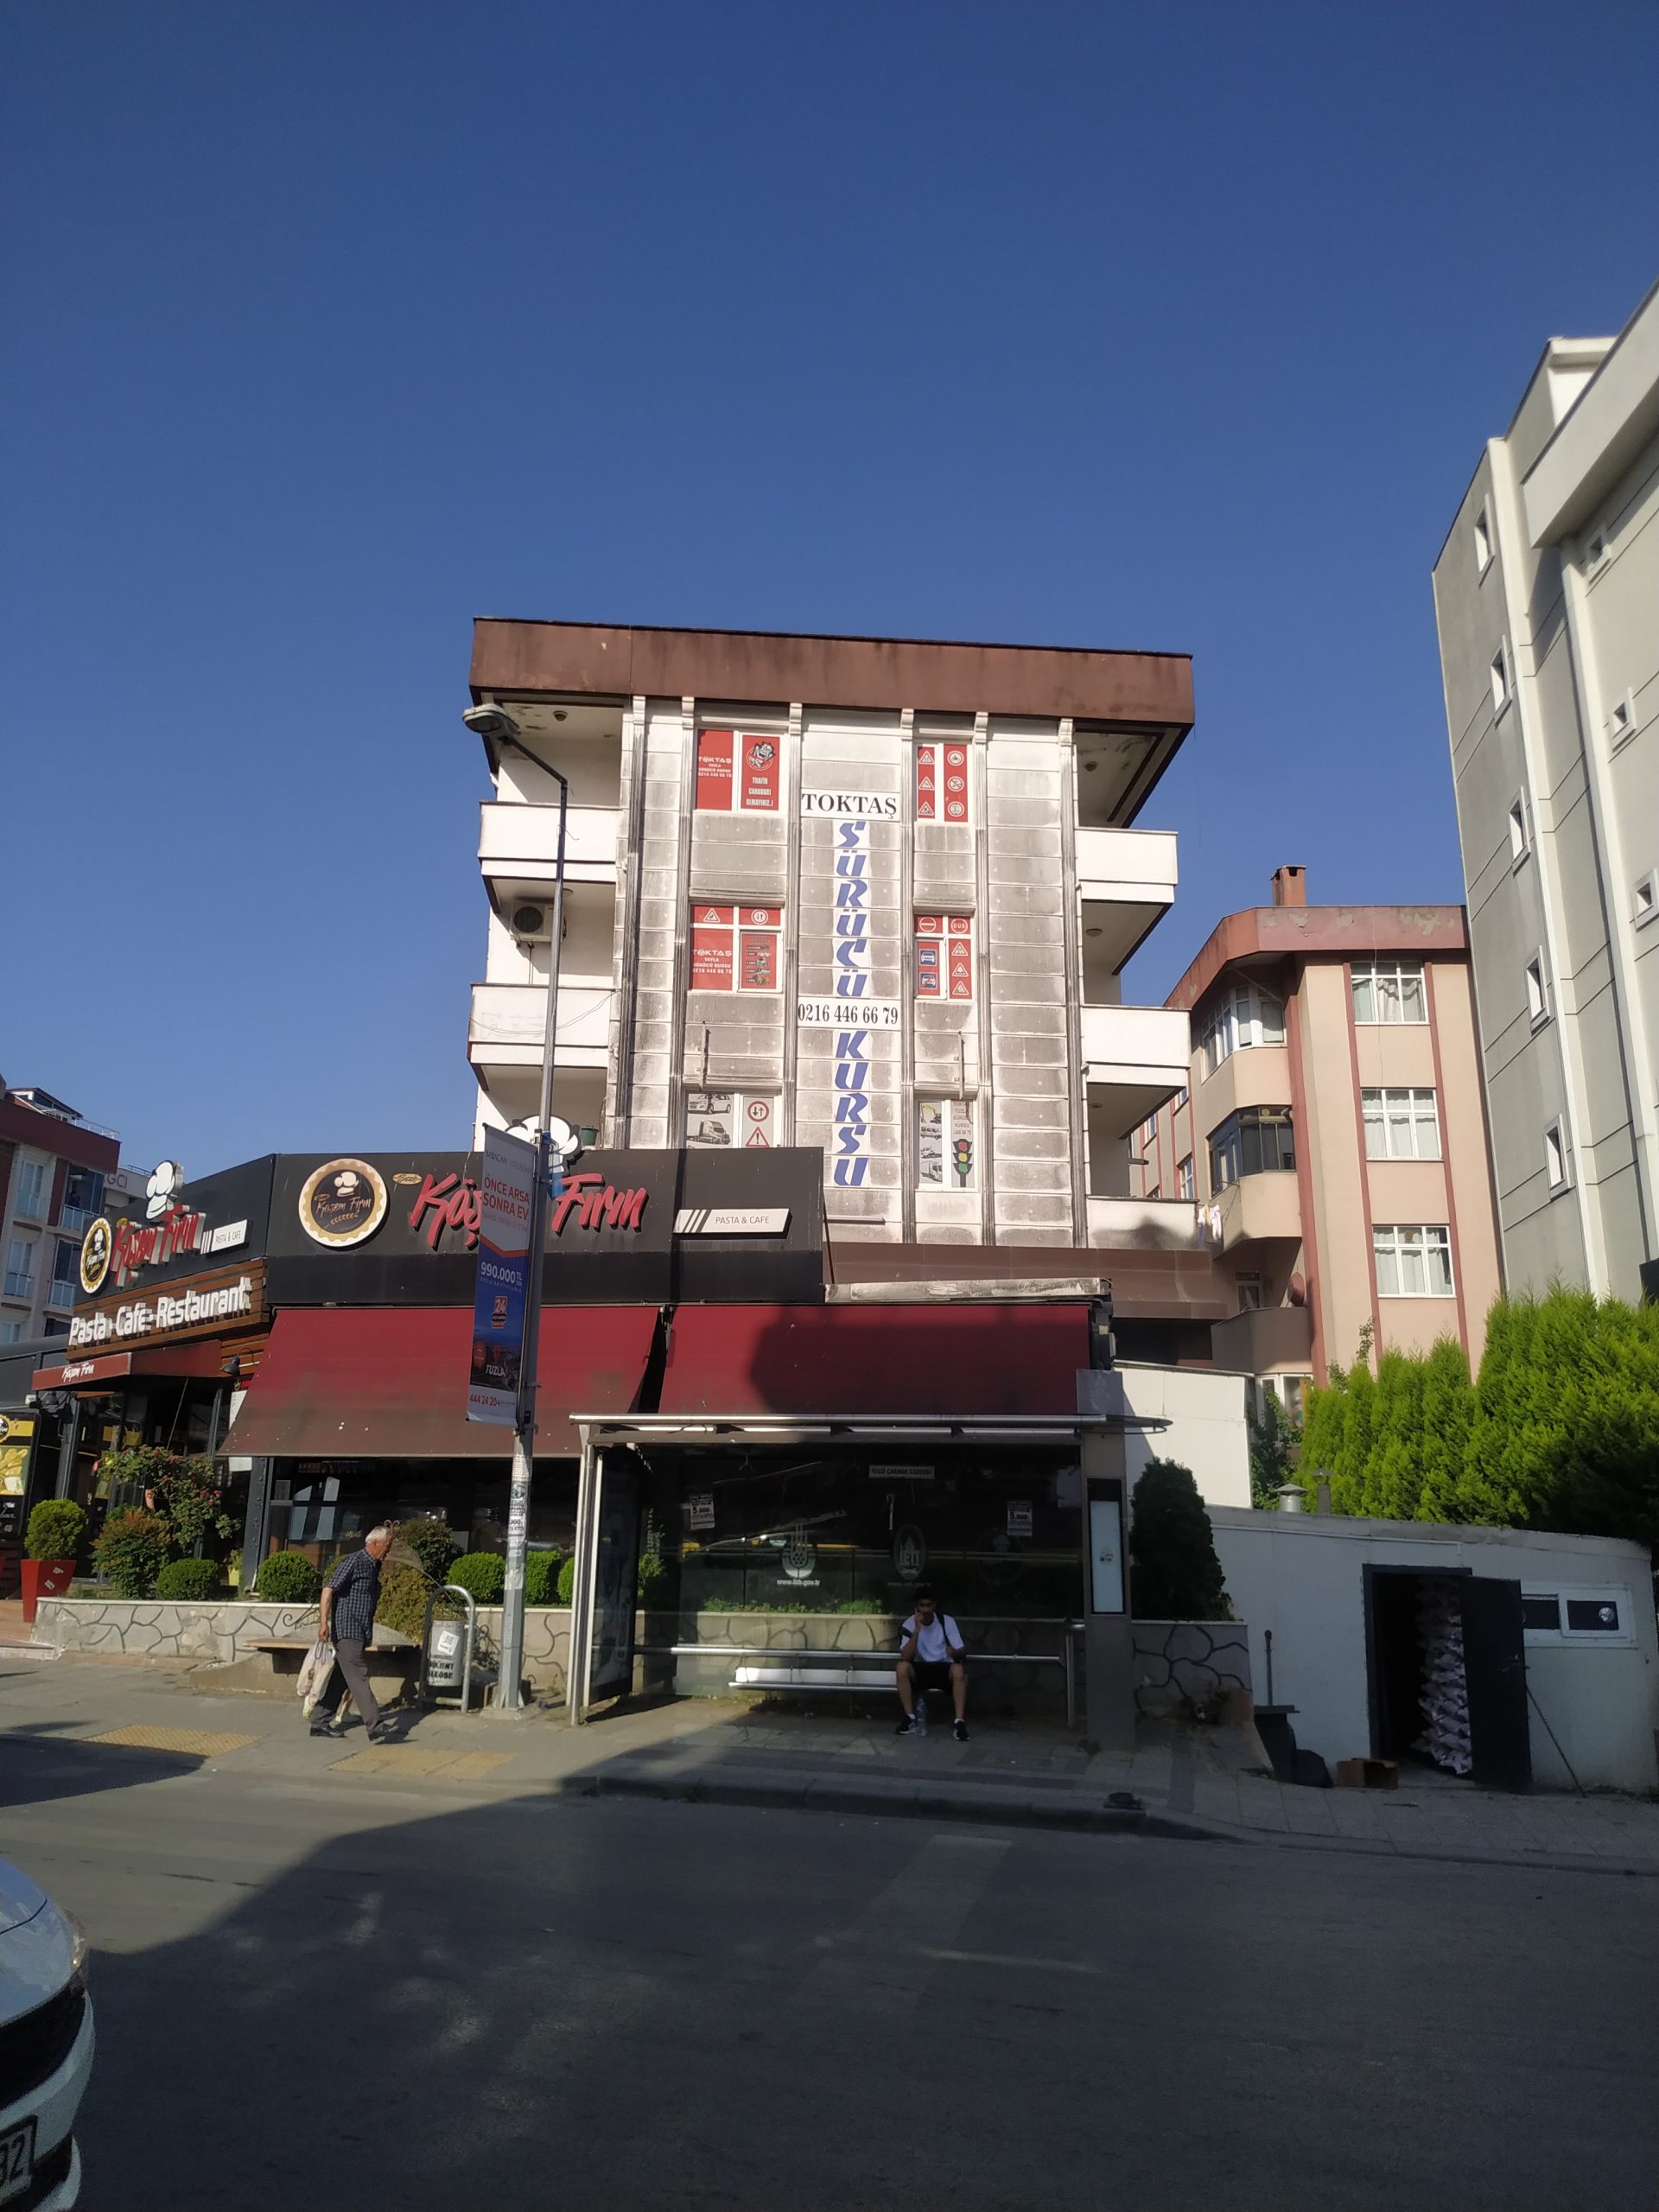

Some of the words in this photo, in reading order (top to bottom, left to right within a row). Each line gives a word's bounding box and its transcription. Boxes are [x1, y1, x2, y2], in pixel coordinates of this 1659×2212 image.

[802, 793, 897, 819] TOKTAŞ
[836, 821, 868, 997] SÜRÜCÜ
[798, 1003, 830, 1022] 0216
[834, 1005, 858, 1023] 446
[863, 1006, 878, 1024] 66
[883, 1007, 898, 1025] 79
[484, 1173, 507, 1196] ÖNCE
[508, 1186, 531, 1205] ARSA
[483, 1192, 516, 1217] SONRA
[518, 1205, 530, 1221] EV
[715, 1216, 740, 1224] PASTA
[749, 1216, 770, 1224] CAFE
[480, 1262, 516, 1284] 990.000
[494, 1298, 505, 1313] 24
[486, 1363, 505, 1377] TUZLA
